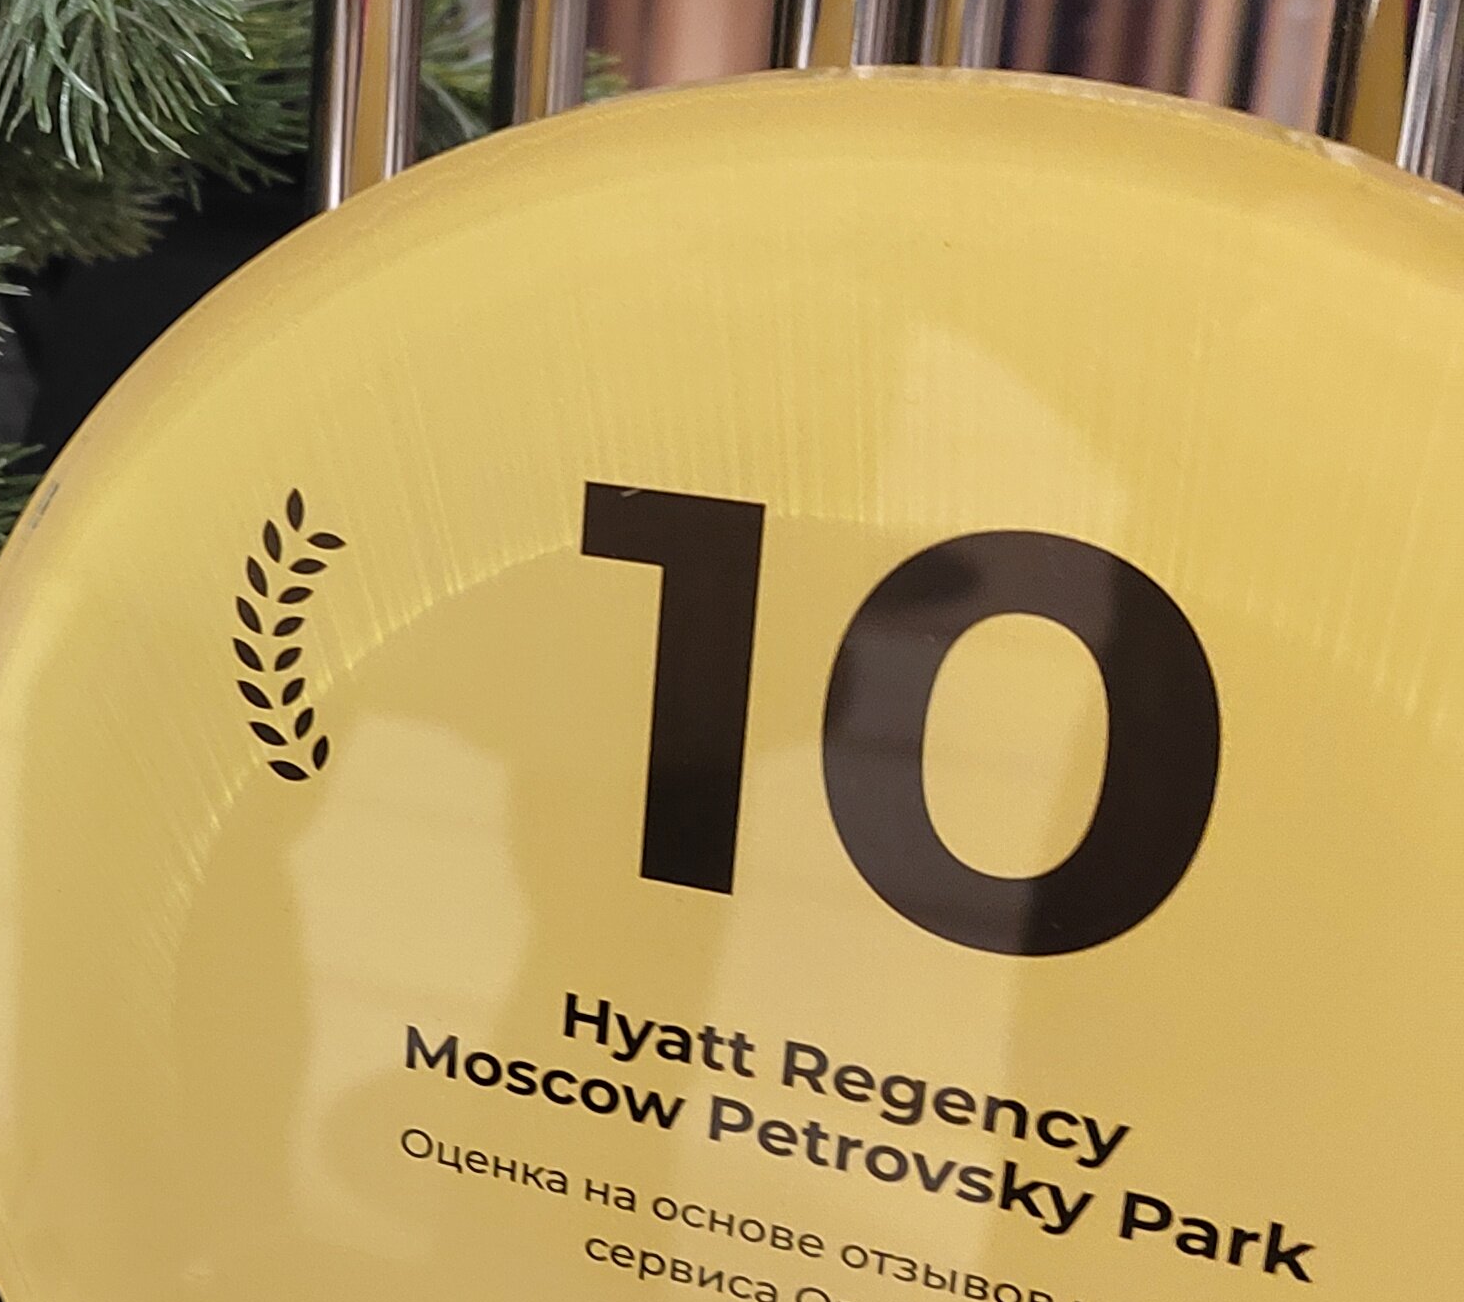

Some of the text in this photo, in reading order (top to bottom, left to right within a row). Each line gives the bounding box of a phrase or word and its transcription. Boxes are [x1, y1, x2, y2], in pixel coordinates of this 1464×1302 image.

[579, 480, 1223, 959] 10
[404, 1023, 1318, 1285] Moscow Petrovsky Park
[561, 990, 1133, 1170] Hyatt Regency
[399, 1127, 570, 1197] Оценка
[583, 1177, 638, 1214] на
[650, 1195, 826, 1260] основе
